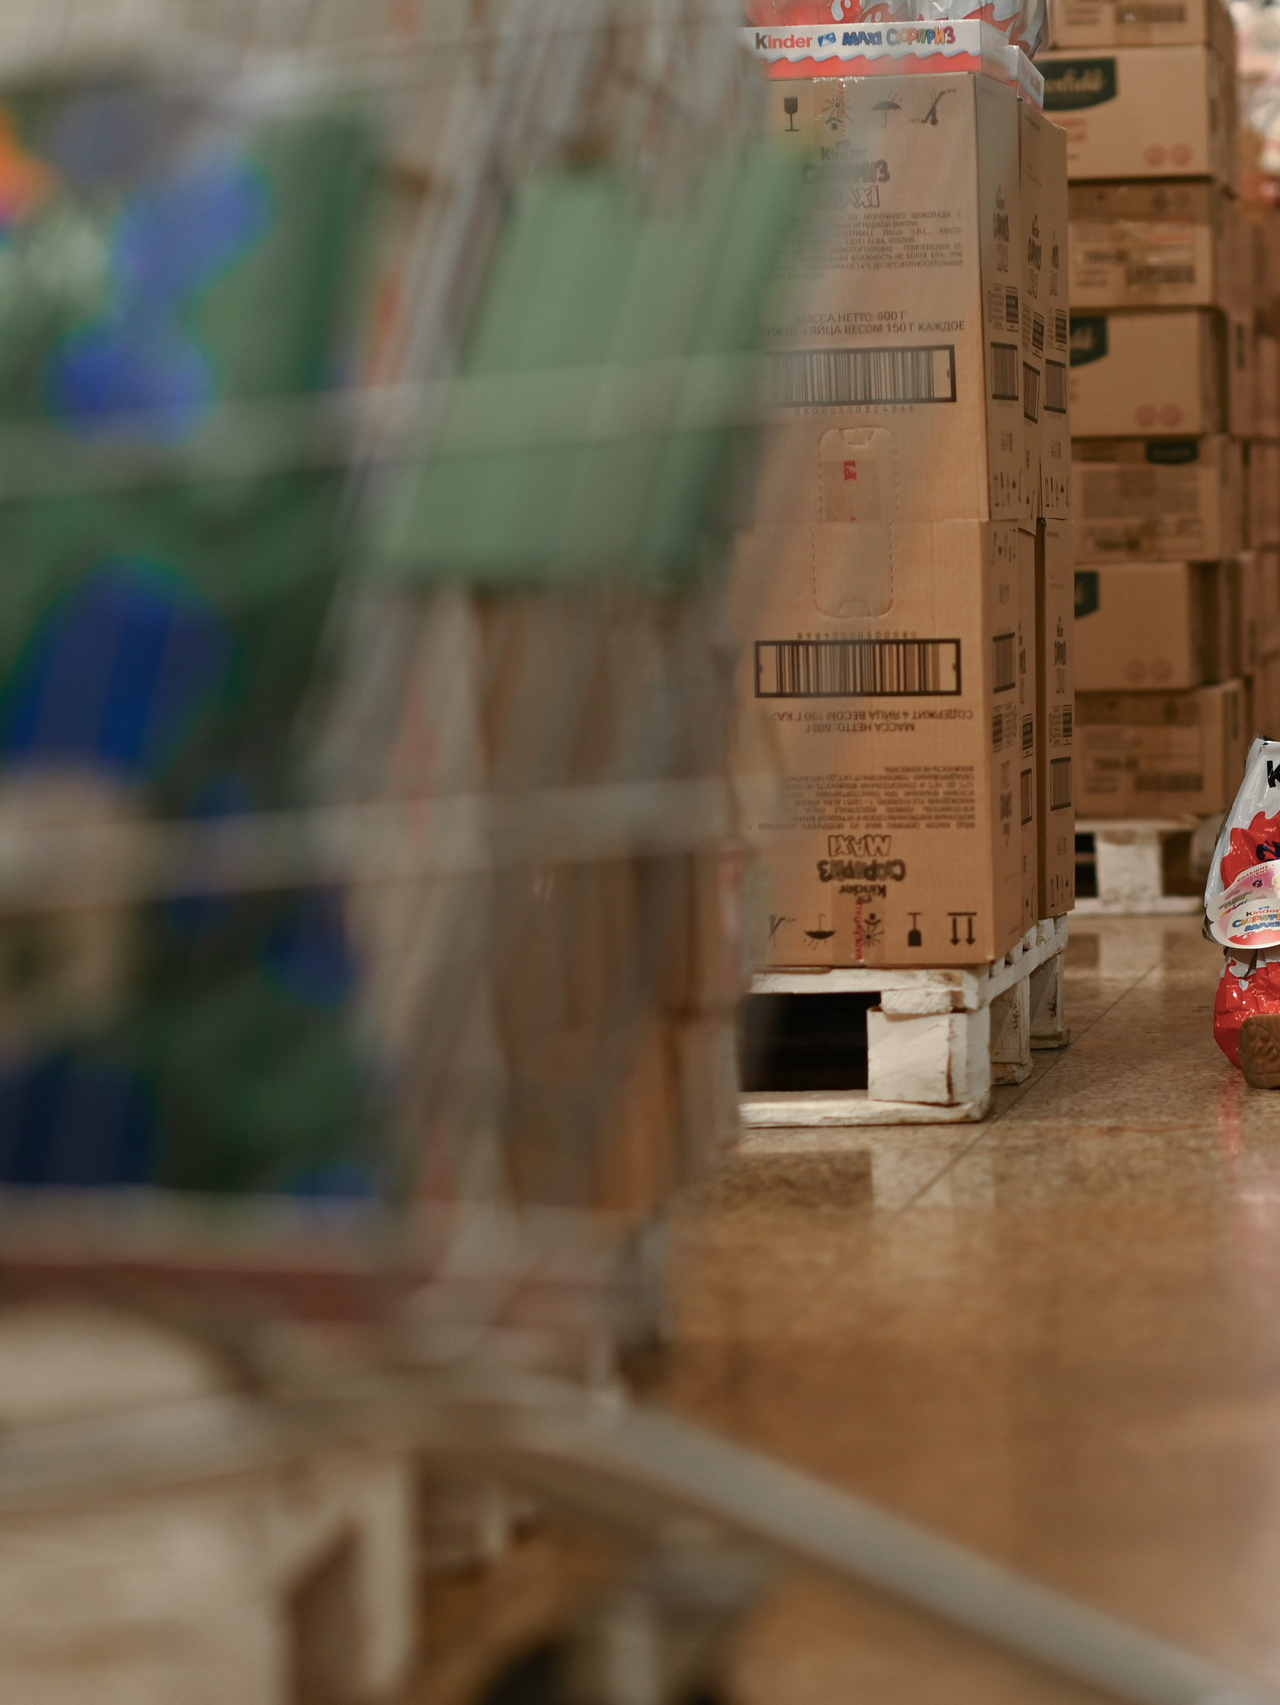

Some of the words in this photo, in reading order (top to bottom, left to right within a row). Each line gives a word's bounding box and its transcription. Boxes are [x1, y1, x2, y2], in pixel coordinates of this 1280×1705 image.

[754, 32, 813, 49] Kinder
[841, 30, 882, 46] MAXI
[886, 25, 957, 46] СЮРПРИЗ
[796, 312, 835, 324] МАССА
[838, 311, 874, 323] НЕТТО:
[876, 310, 898, 321] 600
[900, 310, 908, 321] Г
[809, 323, 842, 336] ЯЙЦА
[844, 322, 884, 335] ВЕСОМ
[886, 322, 906, 333] 150
[918, 319, 966, 333] КАЖДОЕ
[826, 710, 867, 721] ВЕСОМ
[868, 709, 901, 721] ЯЙЦА
[911, 708, 975, 720] СОДЕРЖИТ
[833, 721, 872, 733] НЕТТО:
[874, 721, 916, 732] МАССА
[827, 834, 892, 858] MAXI
[816, 858, 907, 884] СЮРПРИЗ
[839, 884, 886, 898] Kinder
[1245, 908, 1280, 917] Kinder
